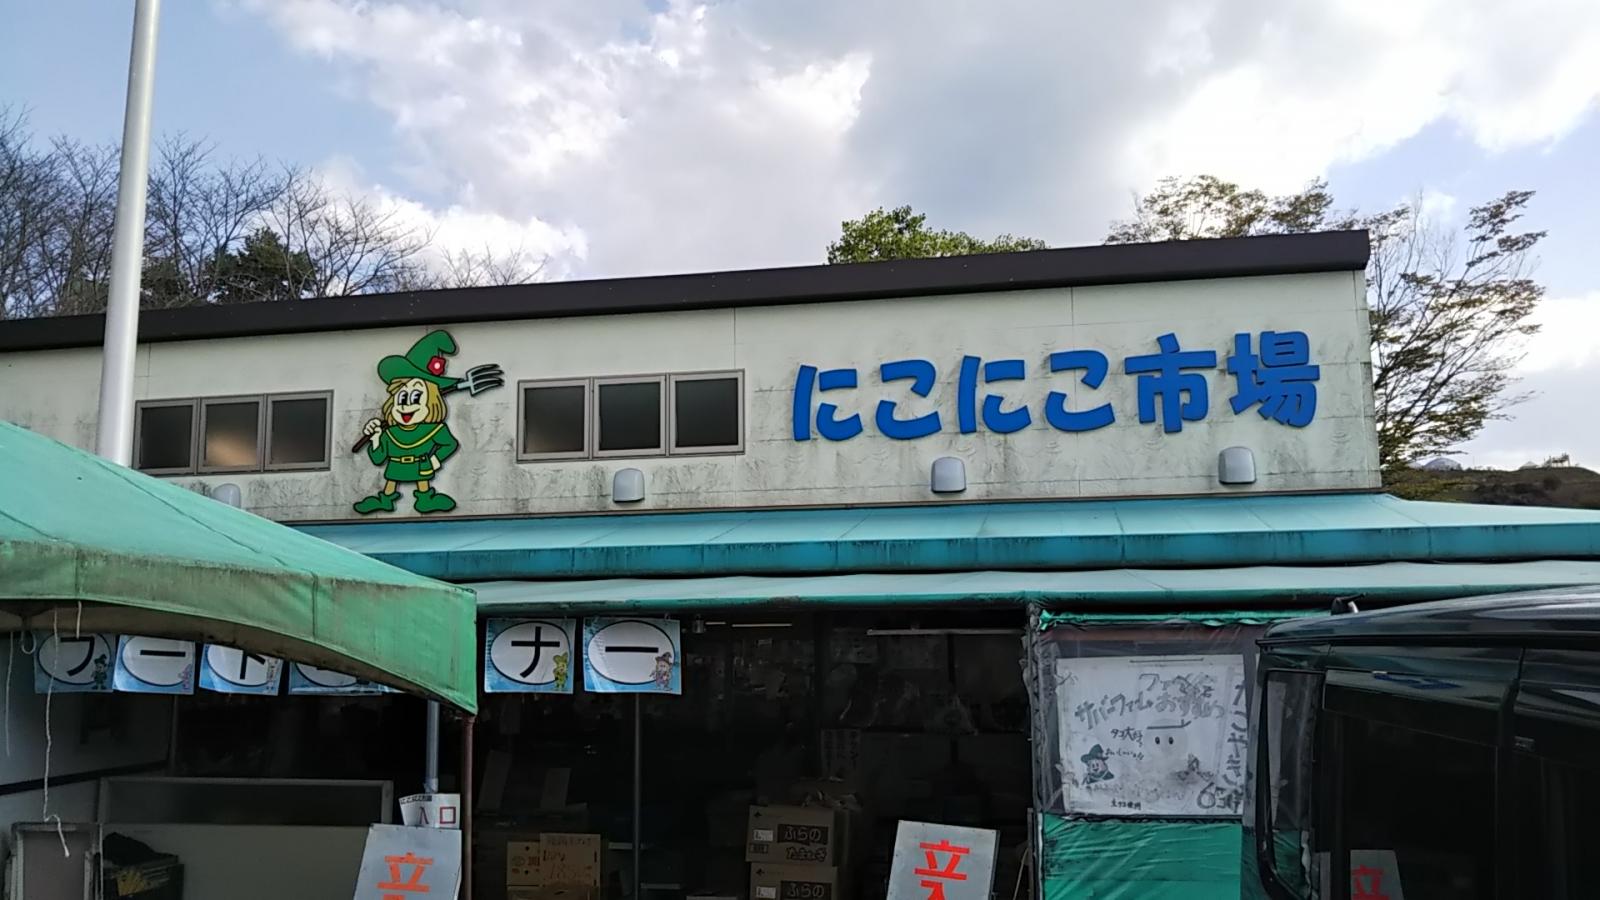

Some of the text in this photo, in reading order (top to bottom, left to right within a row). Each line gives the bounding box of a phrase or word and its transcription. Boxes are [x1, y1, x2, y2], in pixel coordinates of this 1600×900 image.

[793, 331, 1320, 441] にこにこ市場
[376, 852, 434, 900] 立
